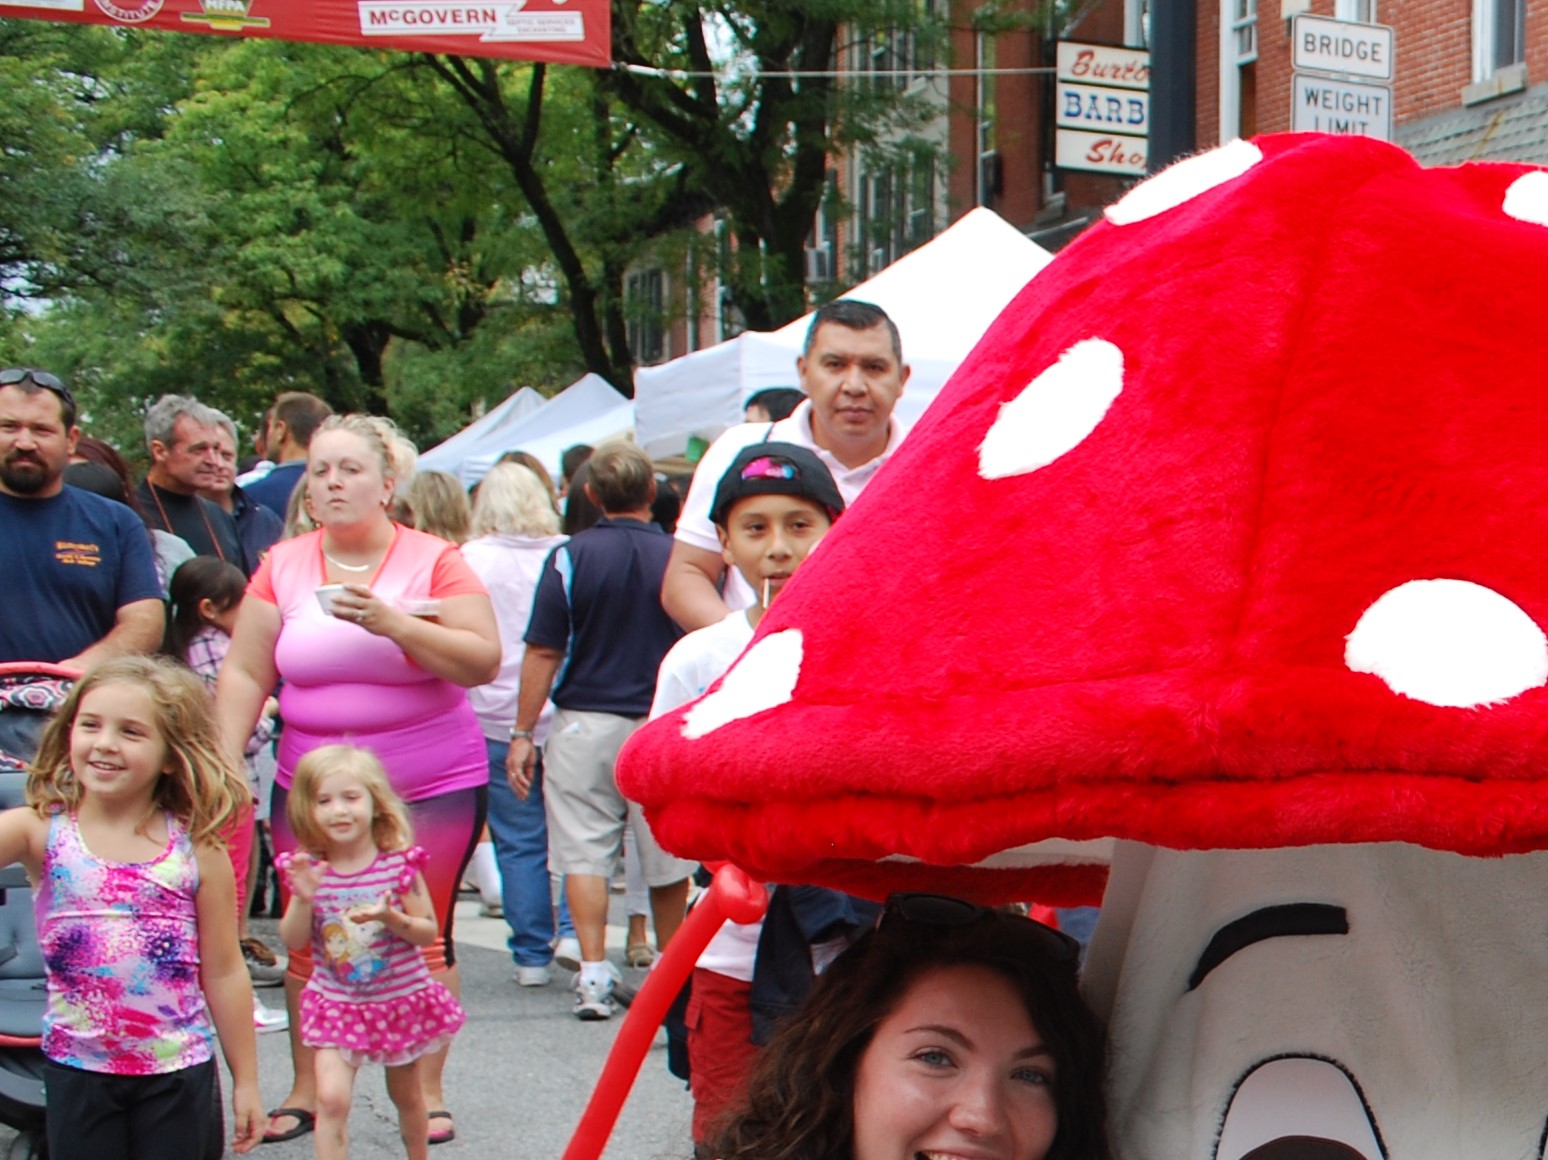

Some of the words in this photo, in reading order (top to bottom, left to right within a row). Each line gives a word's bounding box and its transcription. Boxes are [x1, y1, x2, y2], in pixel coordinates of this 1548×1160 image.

[1304, 32, 1383, 63] BRIDGE
[1071, 49, 1150, 81] Burto
[1063, 91, 1145, 125] BARB
[1304, 86, 1383, 117] WEIGHT
[1085, 139, 1147, 168] Sho
